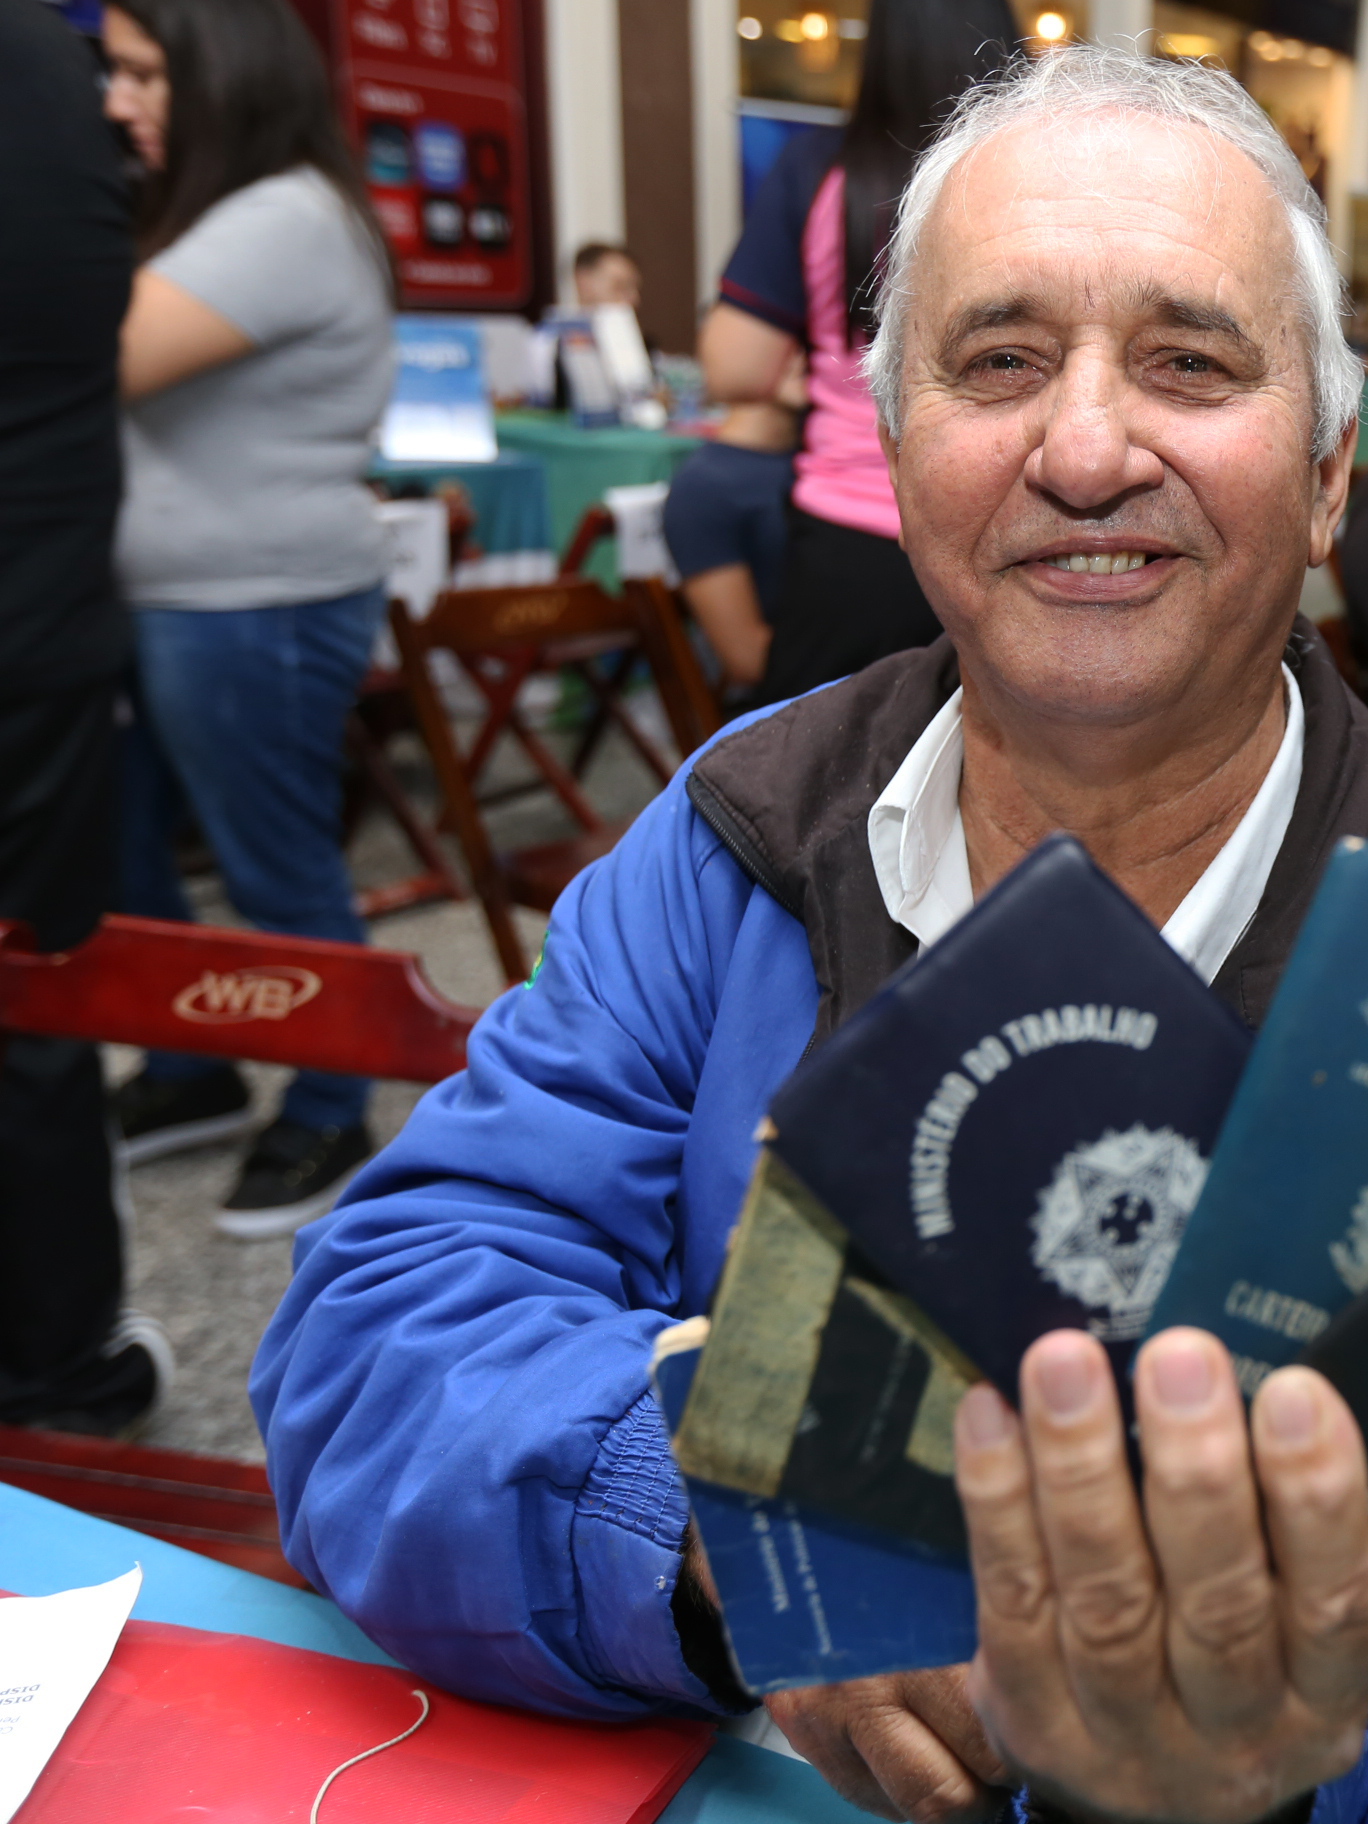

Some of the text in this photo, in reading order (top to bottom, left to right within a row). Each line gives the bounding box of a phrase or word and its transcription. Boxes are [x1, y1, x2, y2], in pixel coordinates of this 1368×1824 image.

[961, 1035, 1012, 1084] DO
[1000, 1004, 1158, 1057] TRABALHO
[1224, 1279, 1330, 1341] CARTEIR
